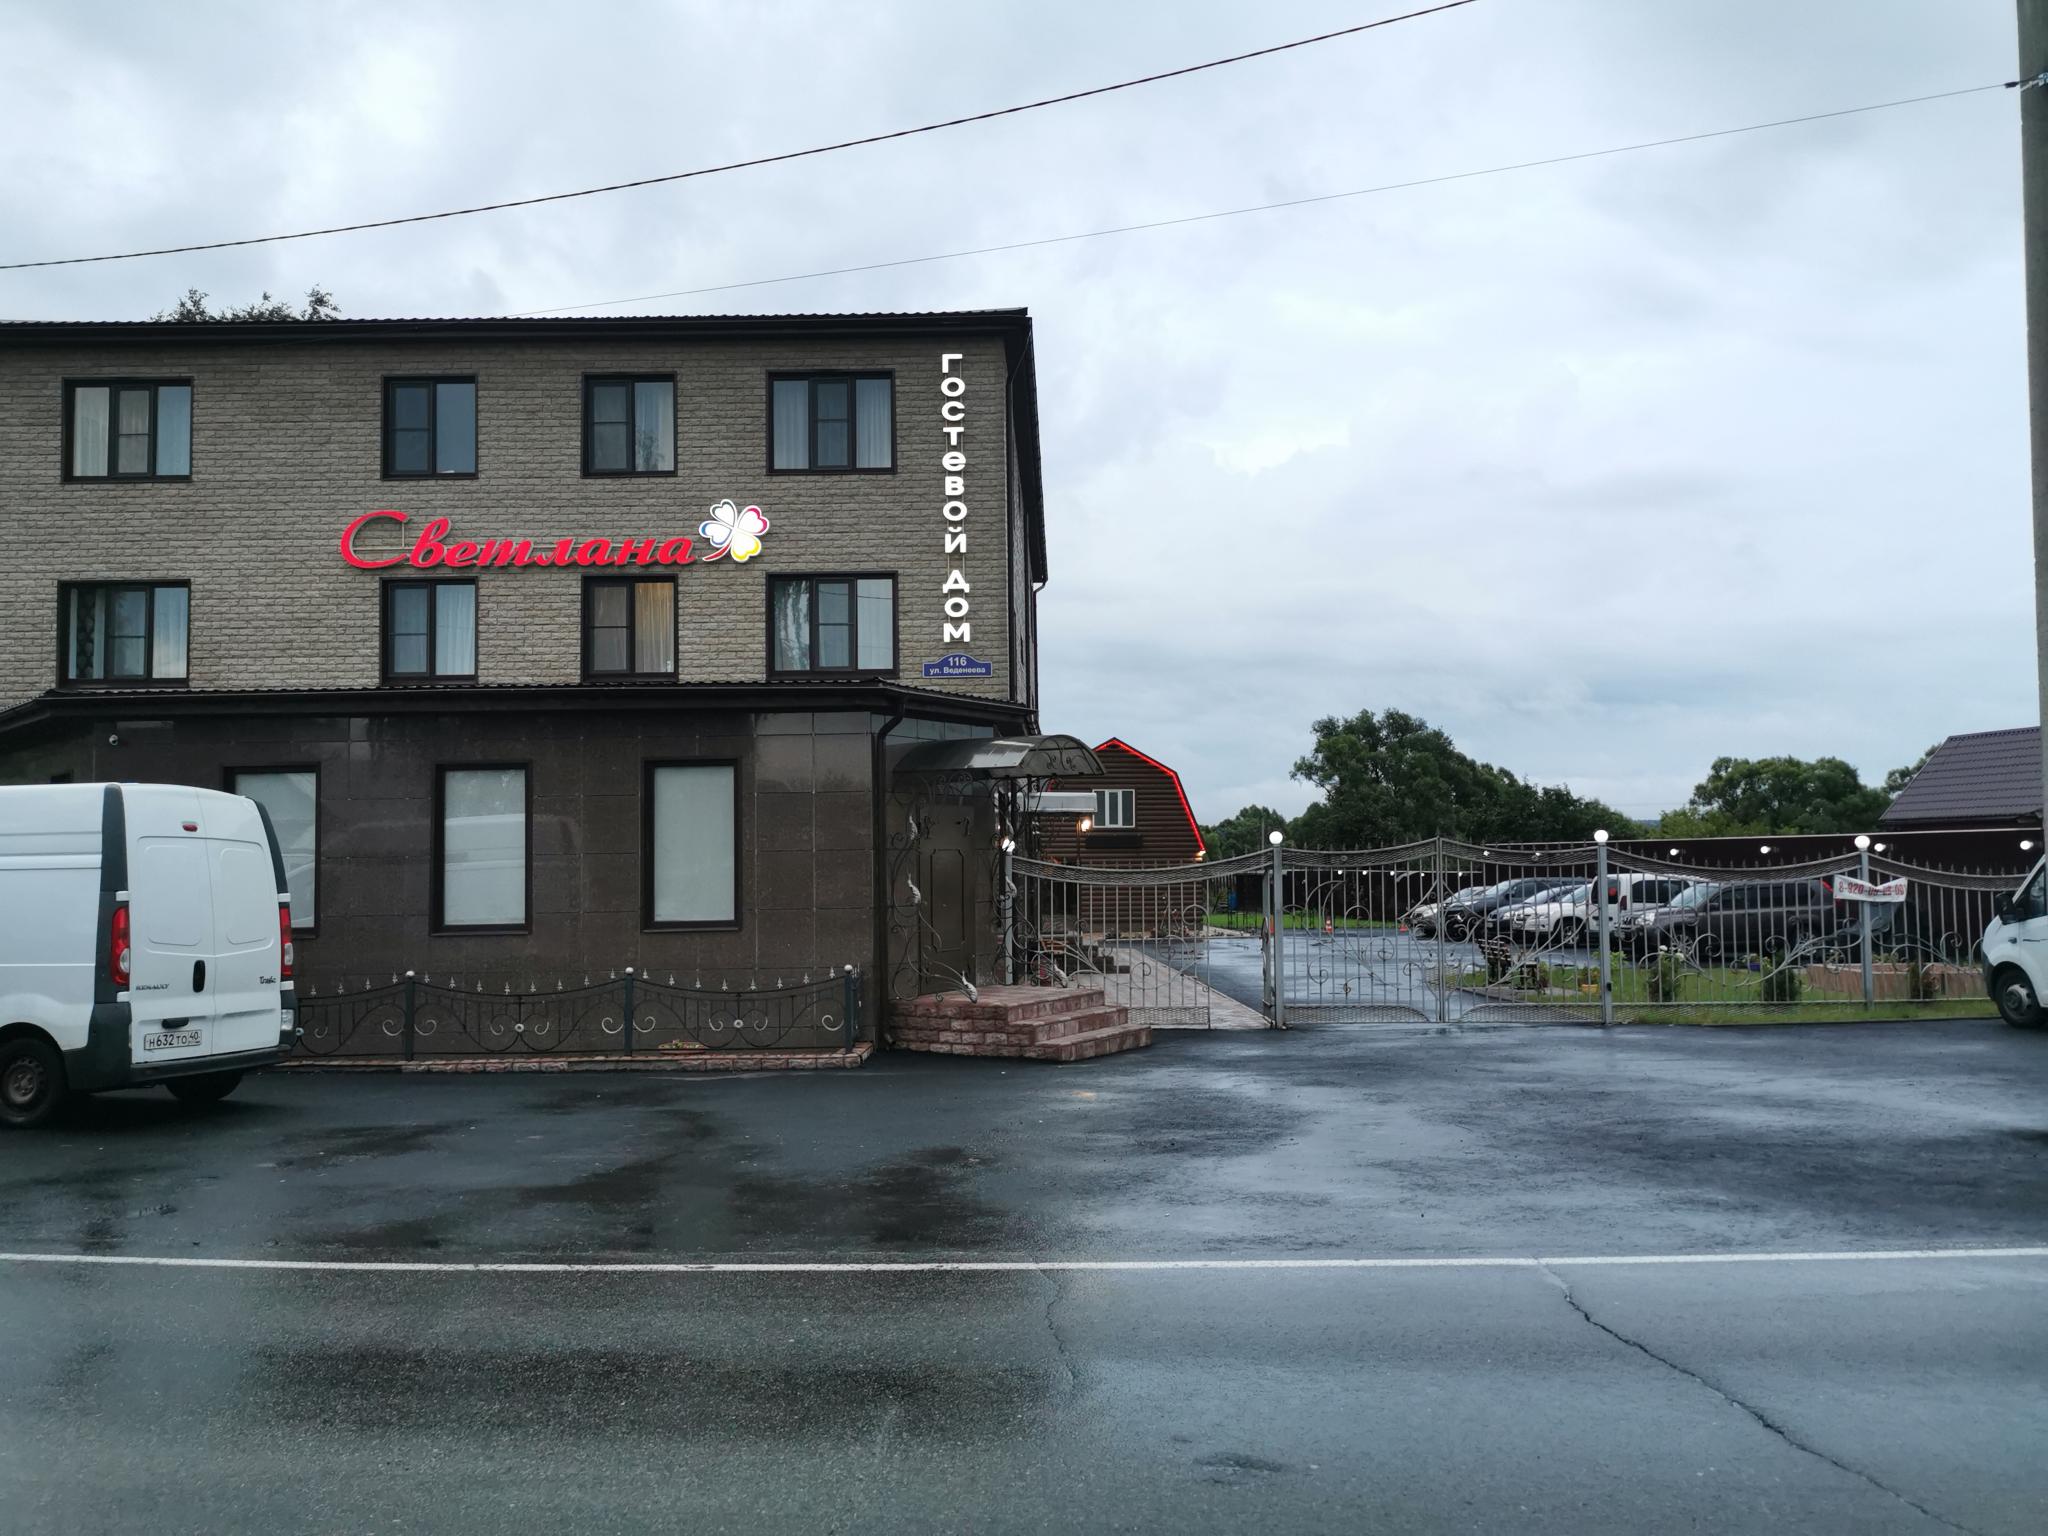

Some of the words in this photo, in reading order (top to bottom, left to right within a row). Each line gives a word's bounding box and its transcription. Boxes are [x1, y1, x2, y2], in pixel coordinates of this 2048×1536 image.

[338, 509, 698, 570] Светлана
[942, 569, 971, 643] ДОМ
[948, 656, 967, 666] 116
